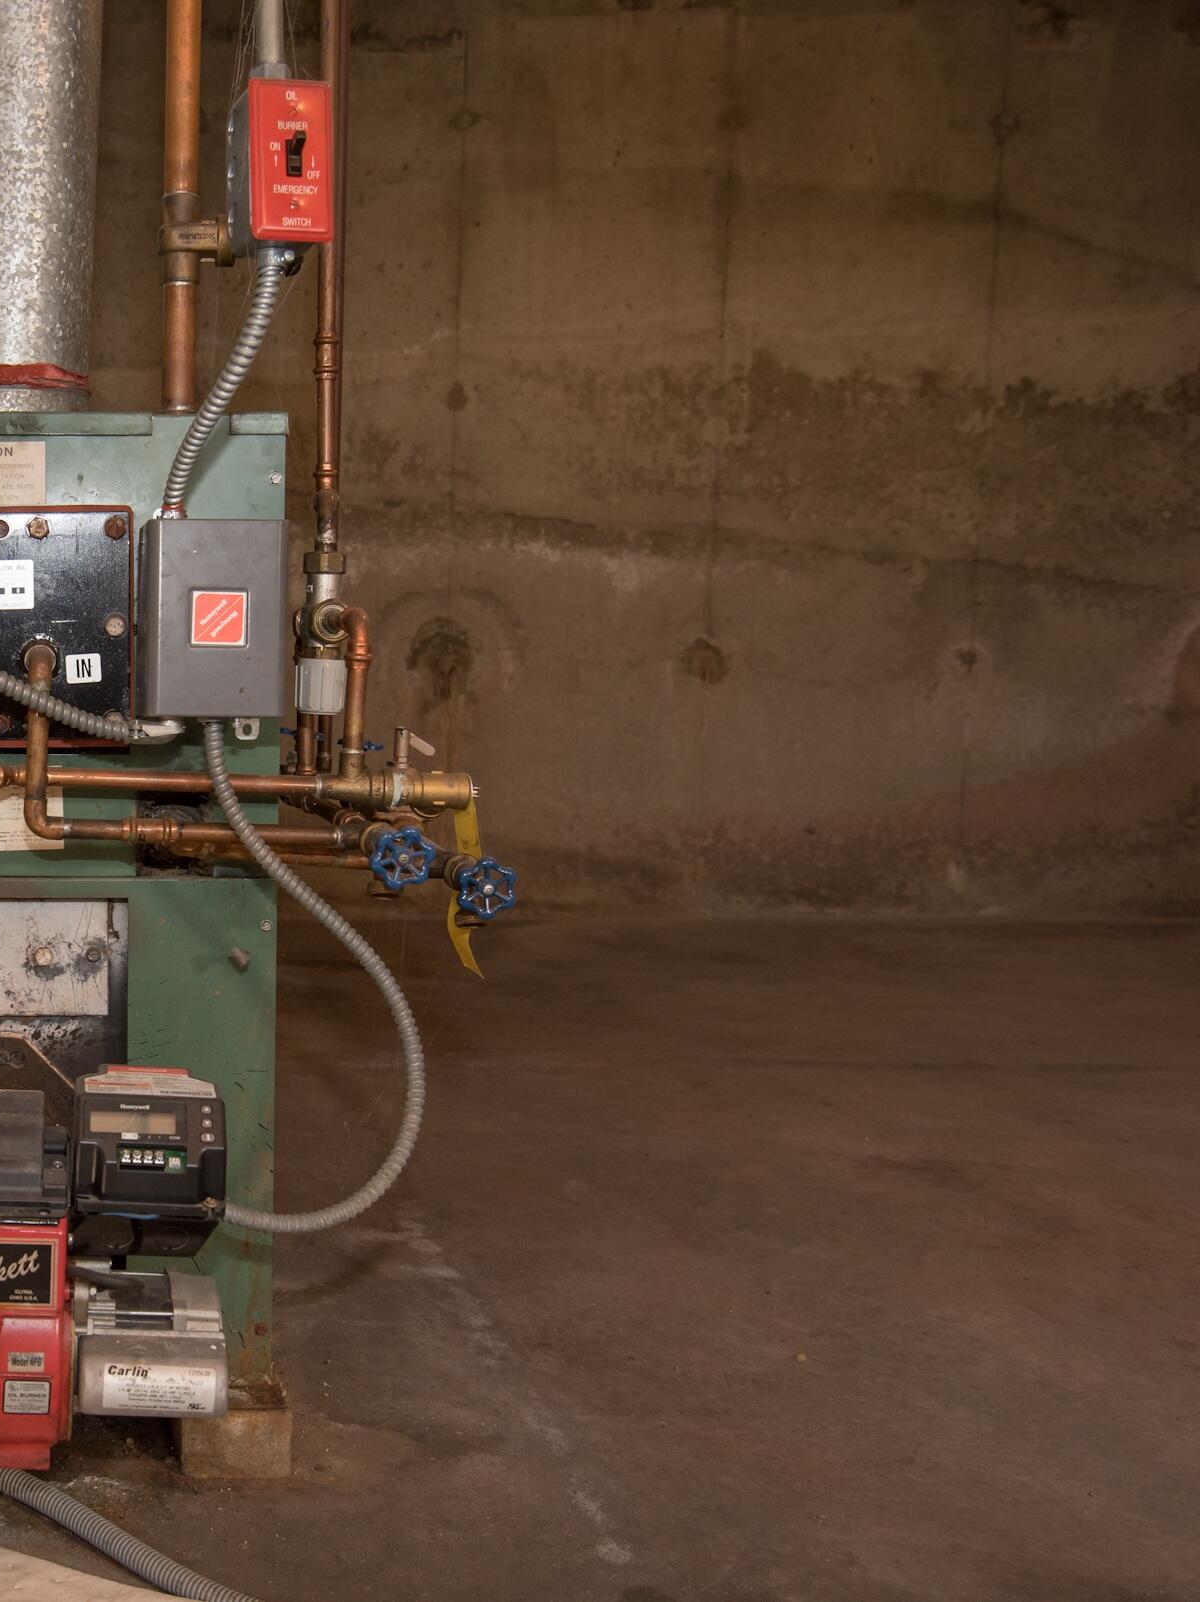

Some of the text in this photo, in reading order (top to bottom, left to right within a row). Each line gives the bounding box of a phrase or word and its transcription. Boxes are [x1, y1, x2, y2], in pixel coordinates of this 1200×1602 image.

[285, 90, 298, 101] OIL
[277, 120, 308, 131] BURNER
[269, 142, 281, 151] ON
[307, 170, 321, 180] OFF
[273, 184, 318, 195] EMERGENCY
[282, 217, 311, 227] SWITCH
[76, 658, 92, 678] IN
[120, 1103, 150, 1111] Honeywell
[107, 1364, 149, 1378] Carlin
